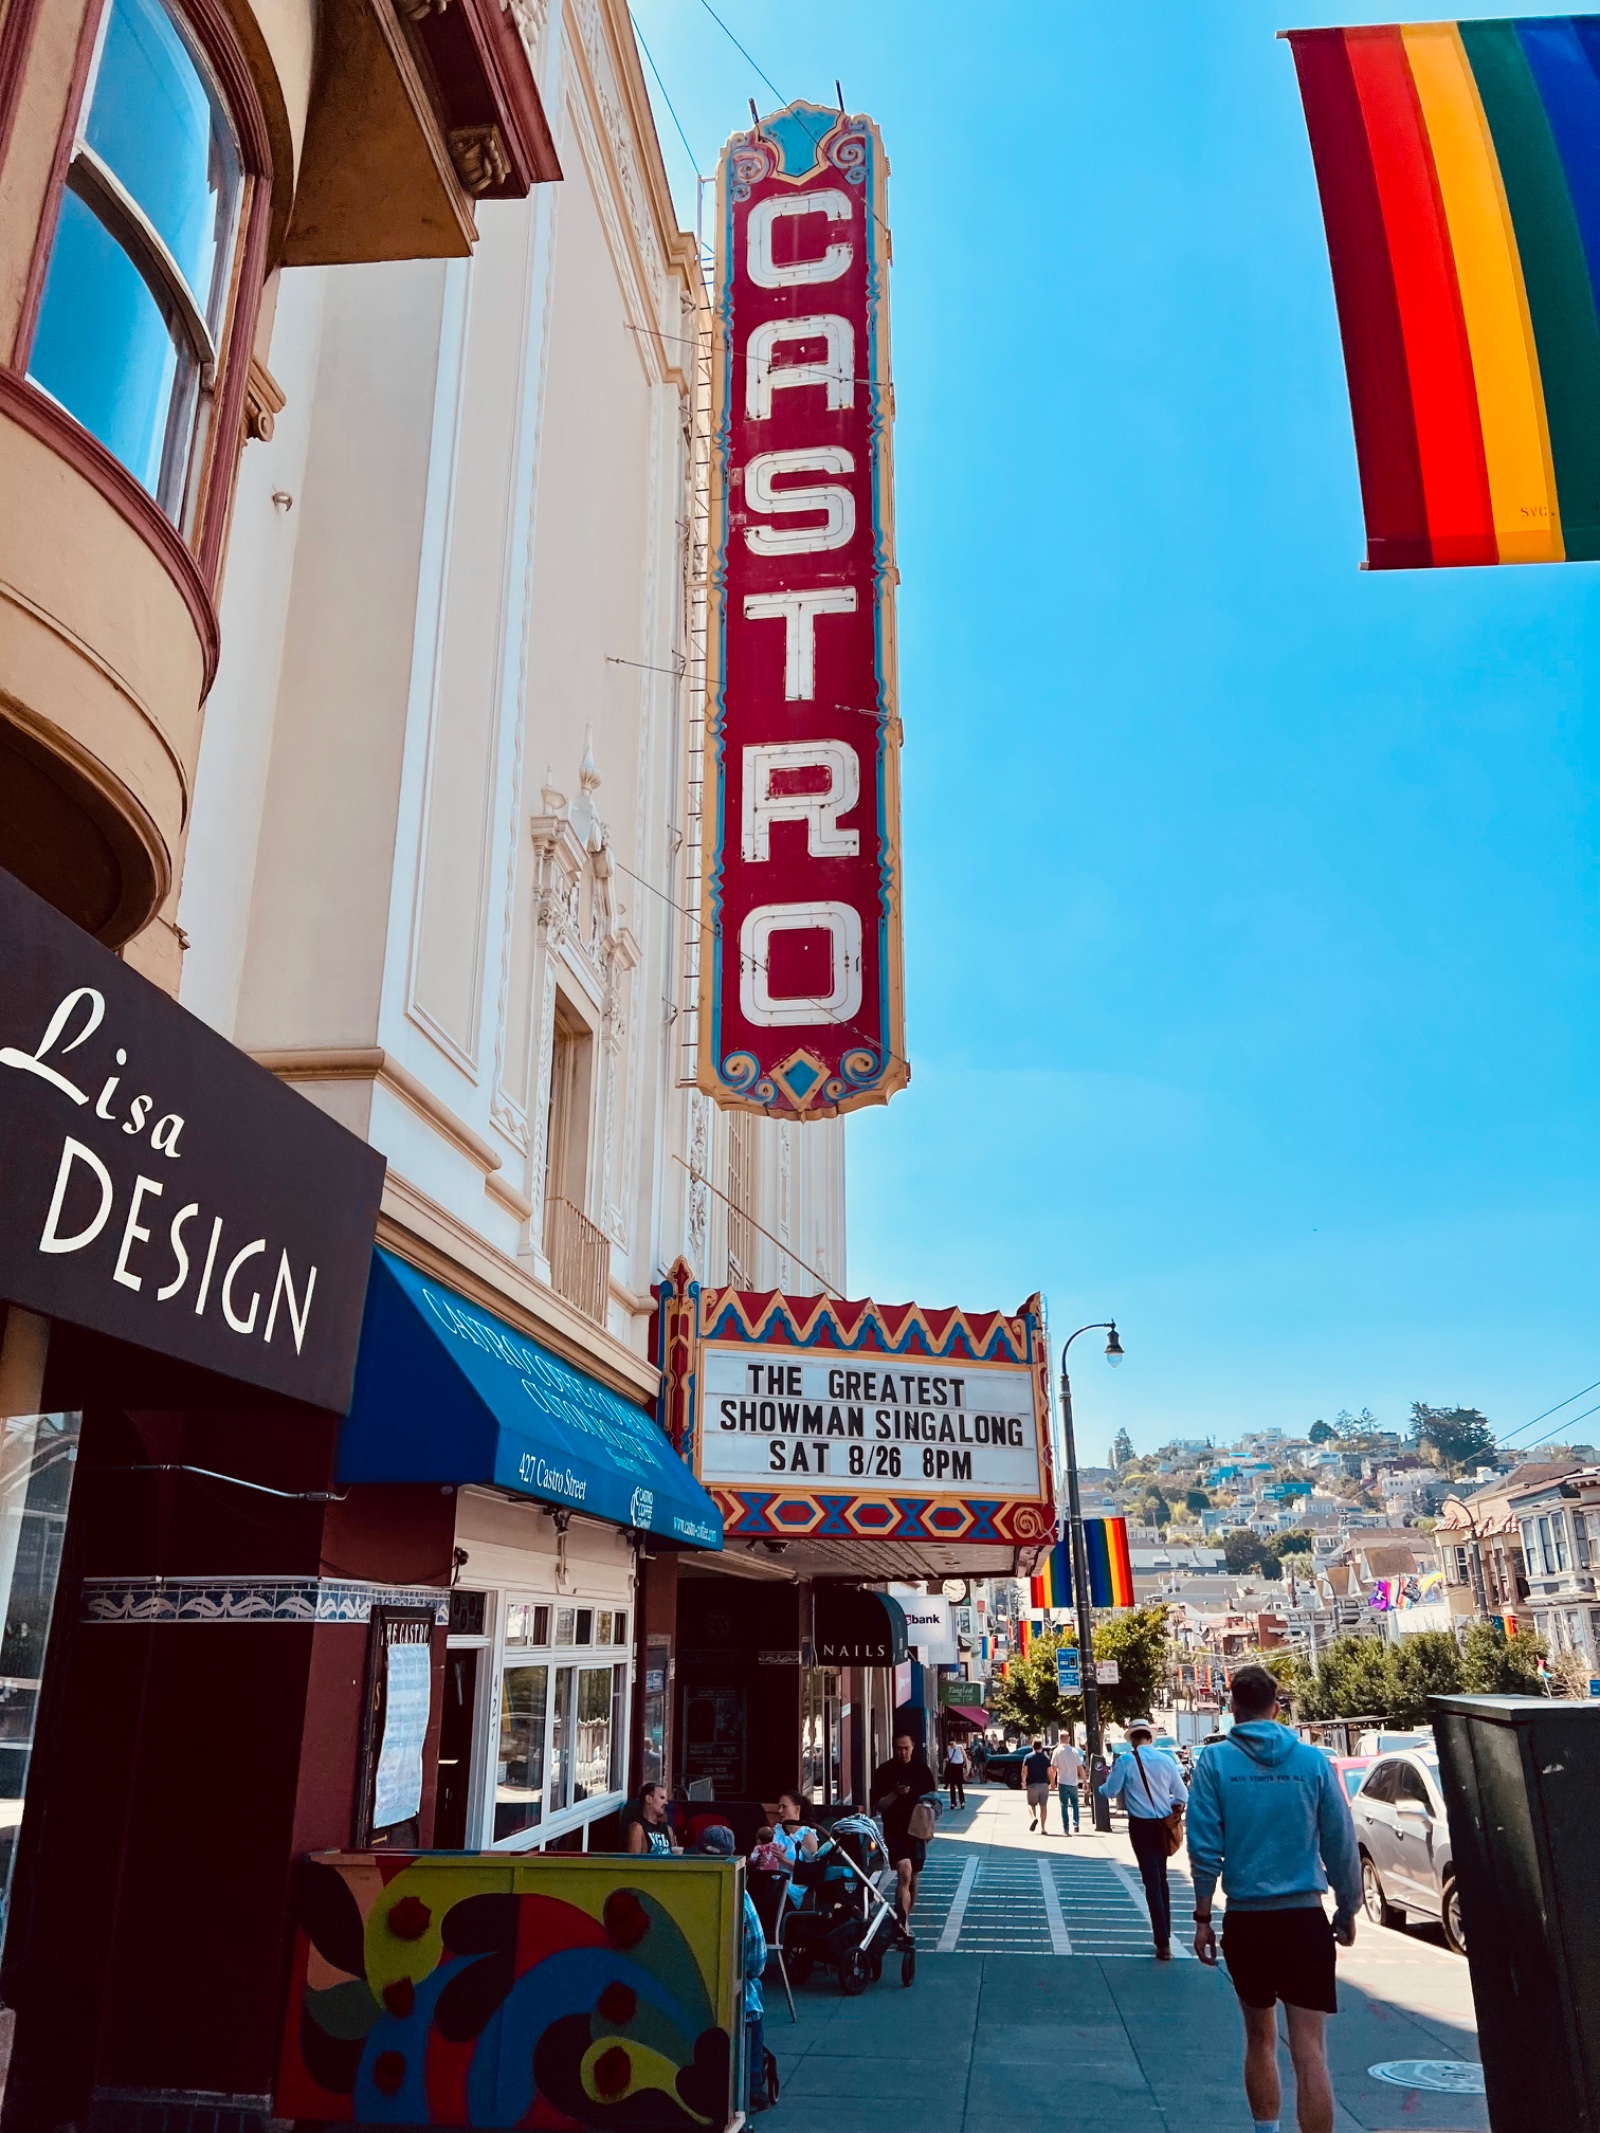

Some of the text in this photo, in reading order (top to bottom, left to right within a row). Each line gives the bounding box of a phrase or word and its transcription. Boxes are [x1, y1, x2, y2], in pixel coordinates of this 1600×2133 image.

[740, 188, 863, 1027] CASTRO
[0, 987, 186, 1158] Lisa
[39, 1135, 318, 1356] DESIGN
[422, 1288, 532, 1375] CASTRO
[522, 1348, 603, 1415] COFFEE
[748, 1364, 965, 1407] THE GREATEST
[720, 1400, 1023, 1447] SHOWMAN SINGALONG
[519, 1452, 587, 1500] 427 Castro Street
[769, 1440, 973, 1480] SAT 8/26 8PM
[823, 1644, 885, 1657] NAILS
